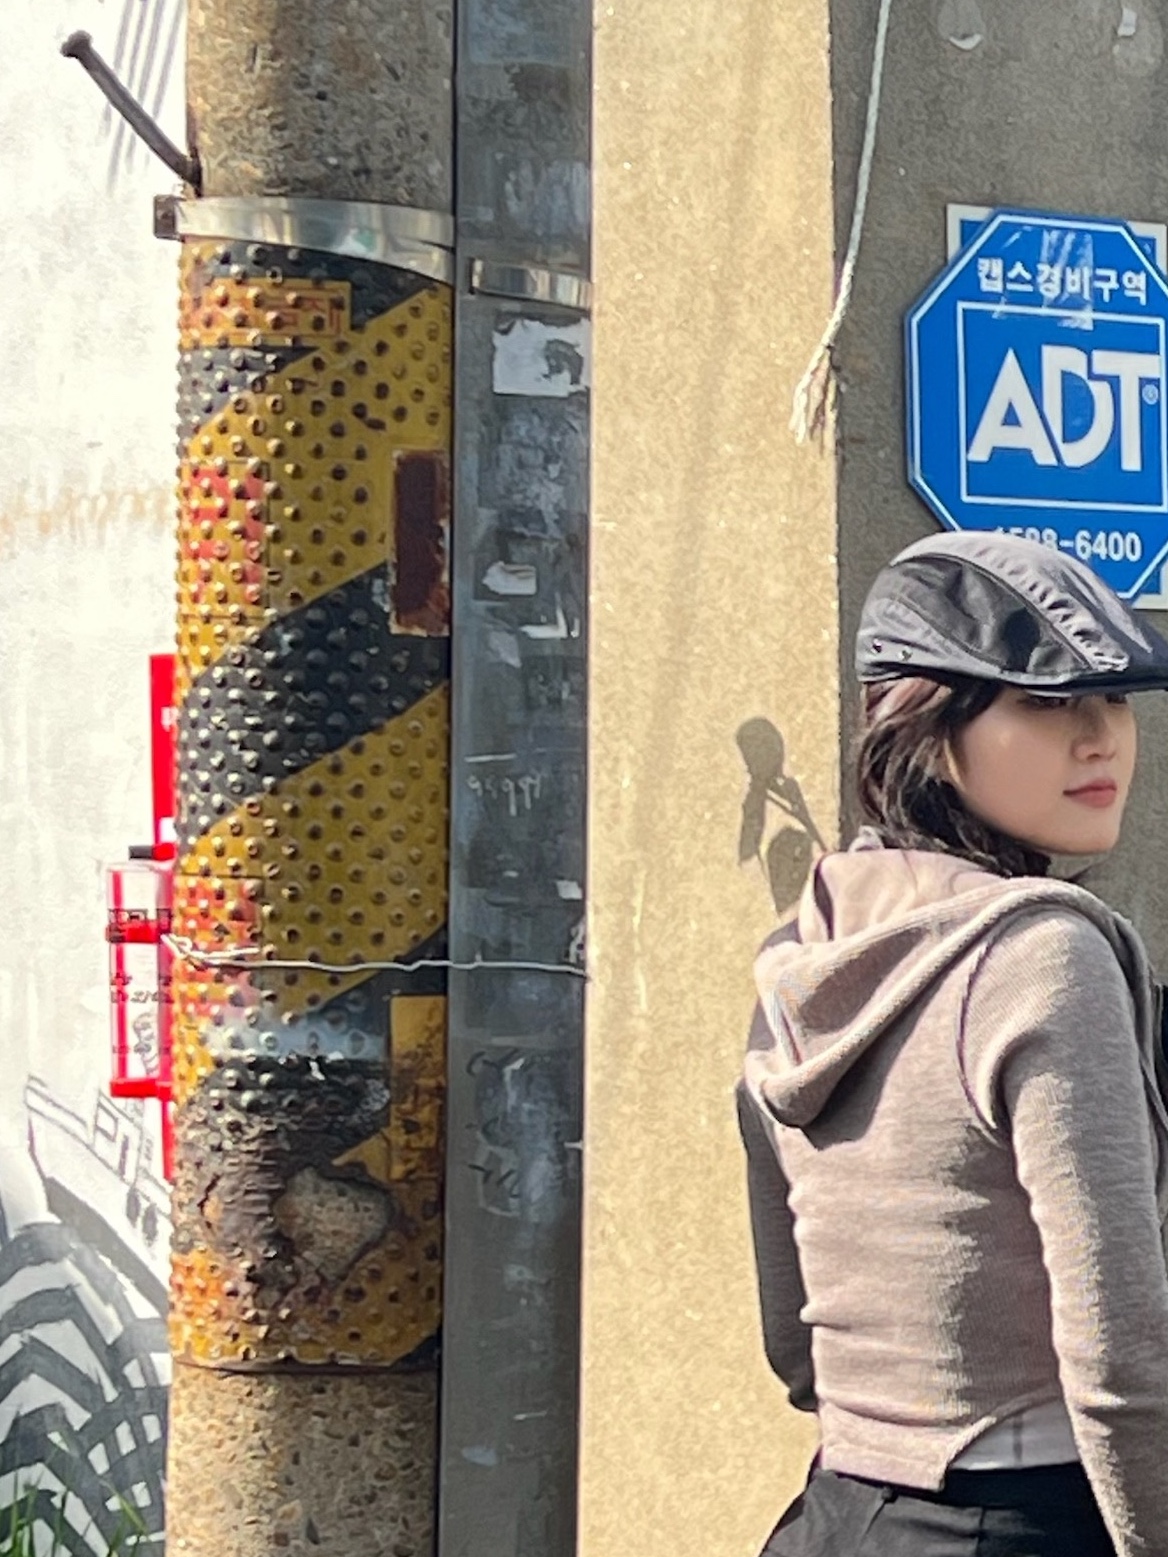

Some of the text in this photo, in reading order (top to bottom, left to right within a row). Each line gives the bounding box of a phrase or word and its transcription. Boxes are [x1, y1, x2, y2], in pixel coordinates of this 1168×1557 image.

[977, 257, 1147, 306] 캡스경비구역
[967, 344, 1161, 472] ADT
[995, 526, 1142, 562] 8-6400
